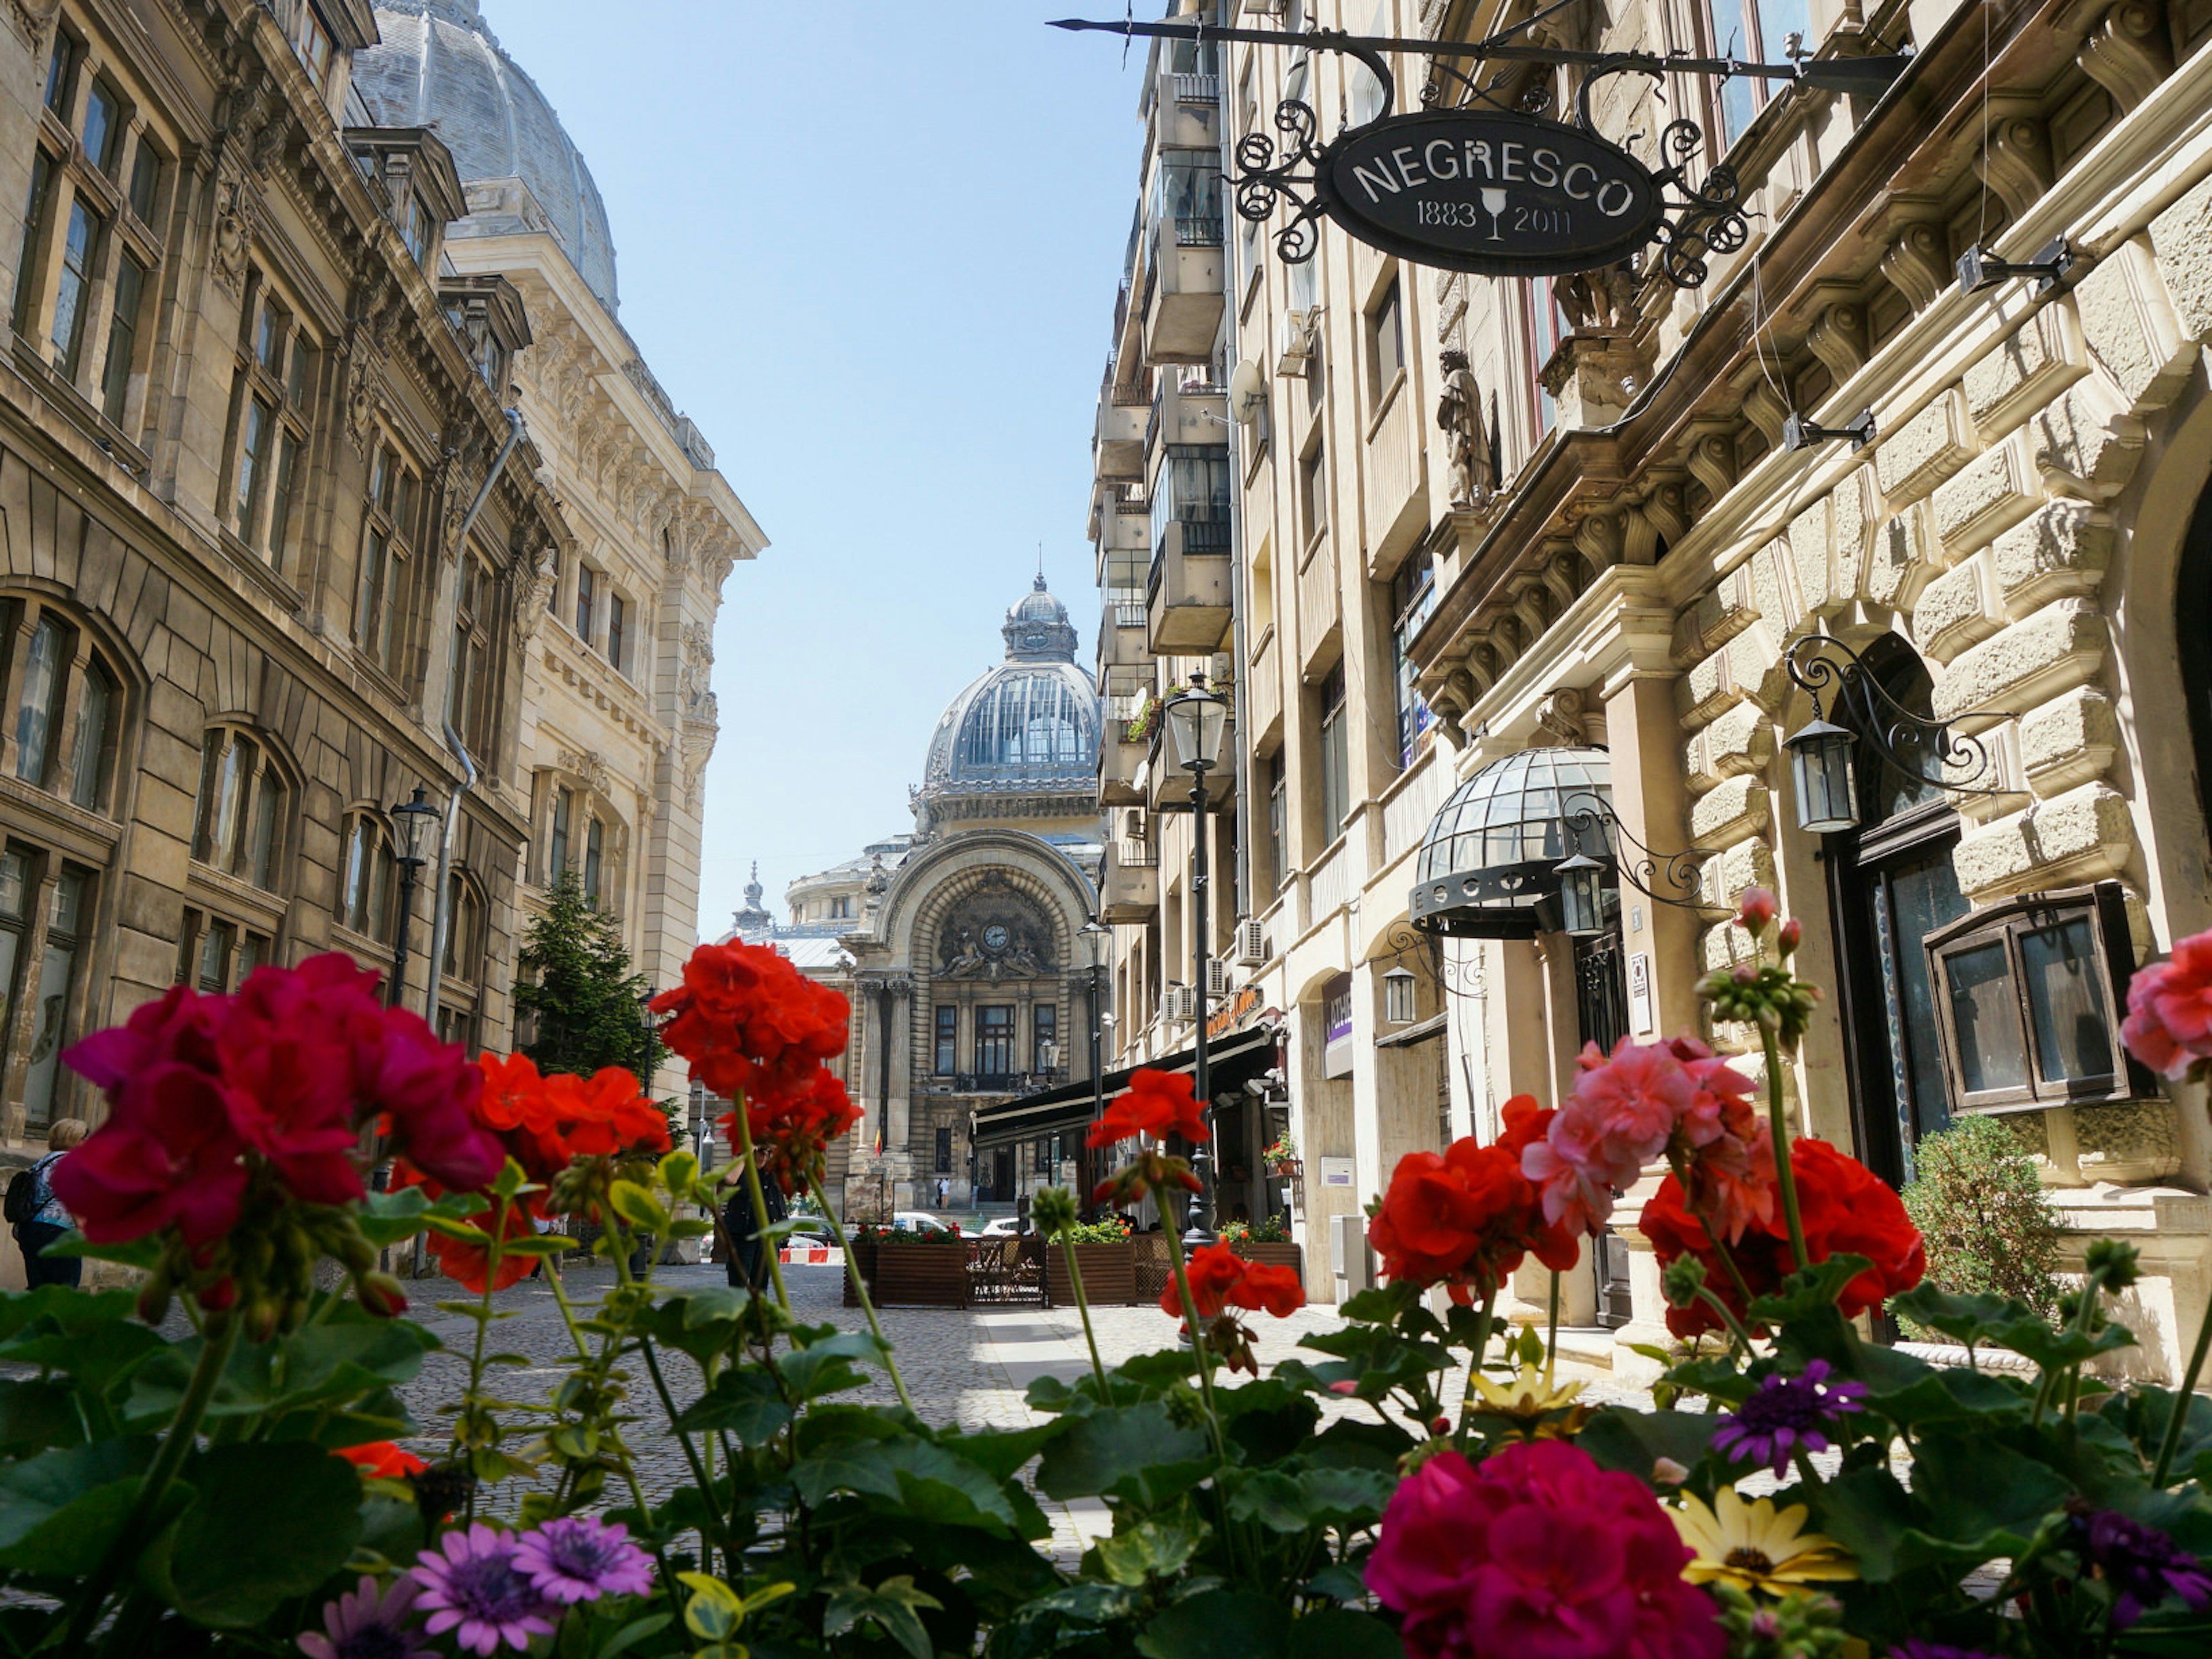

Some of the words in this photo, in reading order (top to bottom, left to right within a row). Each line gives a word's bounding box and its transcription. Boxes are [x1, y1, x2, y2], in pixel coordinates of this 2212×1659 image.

[1352, 138, 1634, 217] NEGRESCO
[1417, 199, 1477, 228] 1883
[1514, 206, 1572, 234] 2011
